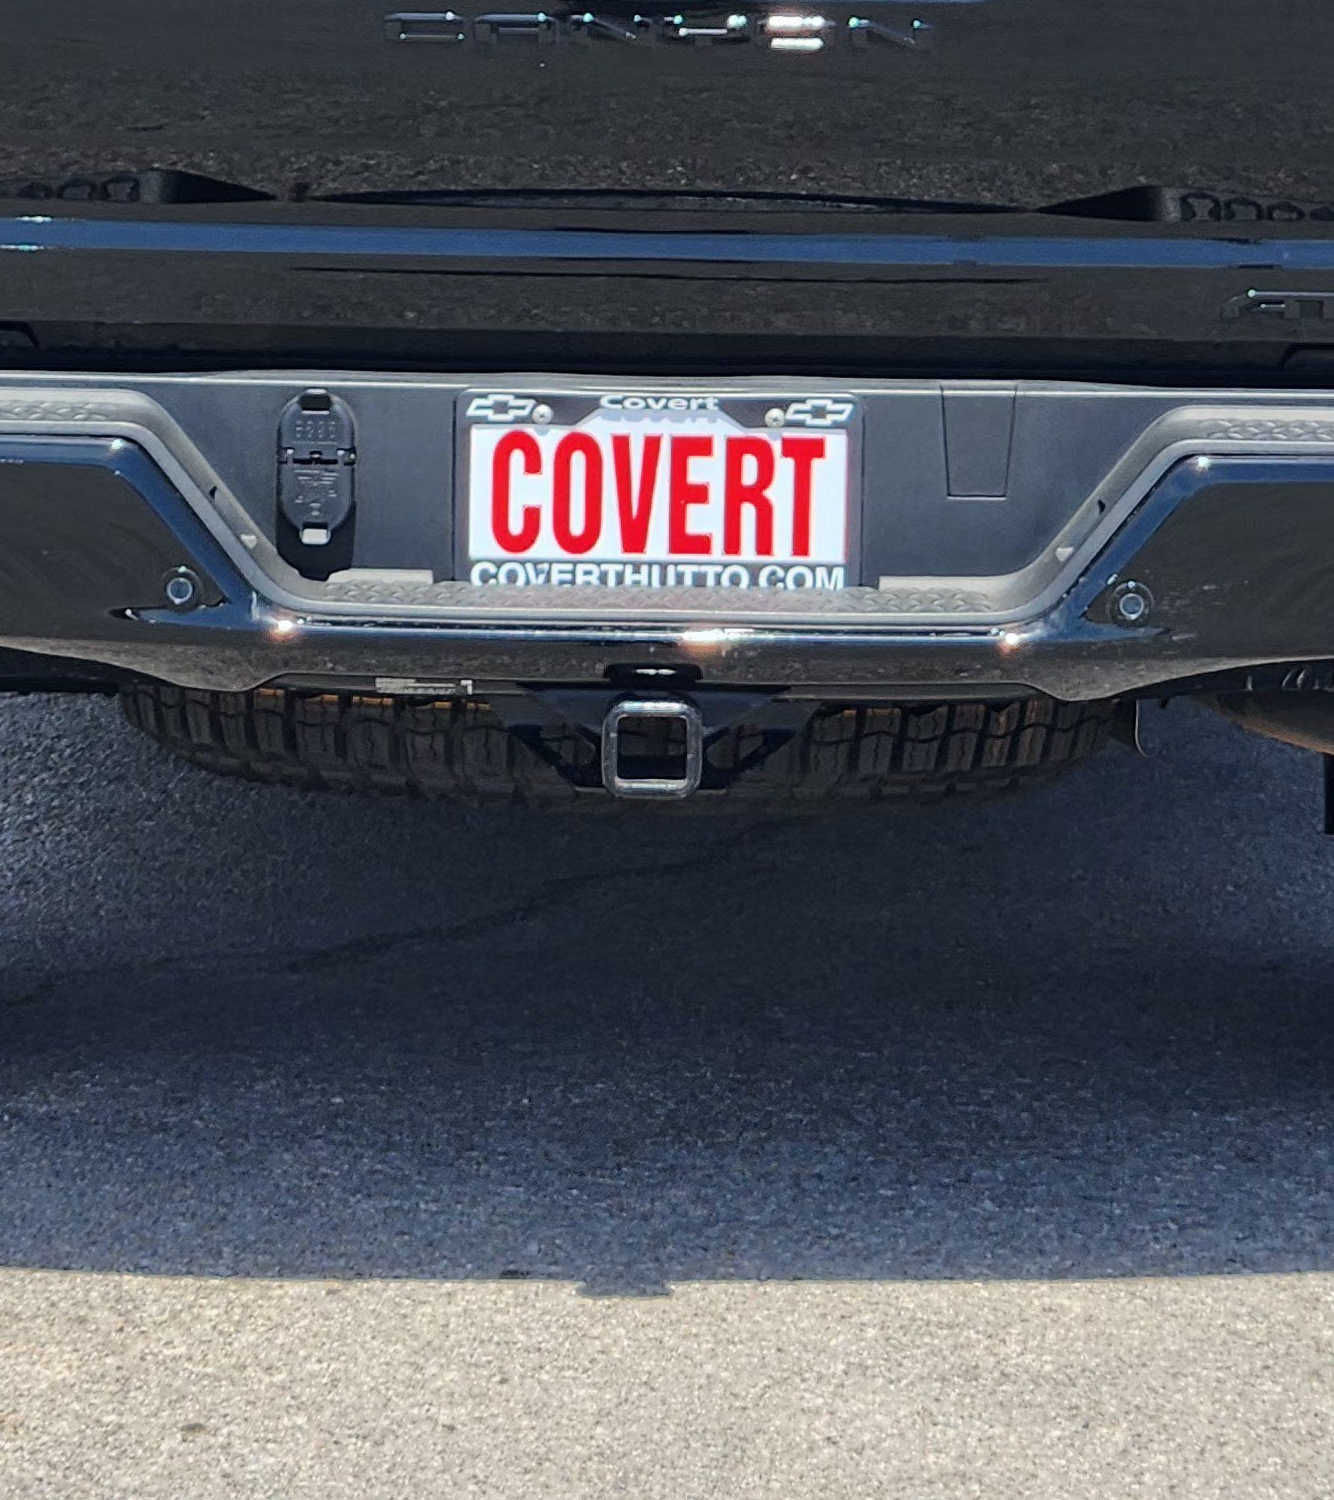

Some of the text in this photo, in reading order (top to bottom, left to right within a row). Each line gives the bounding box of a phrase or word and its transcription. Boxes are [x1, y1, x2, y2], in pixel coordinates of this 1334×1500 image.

[600, 394, 719, 410] Covert
[491, 430, 825, 557] COVERT
[469, 561, 845, 589] COVERTHUTTOCOM
